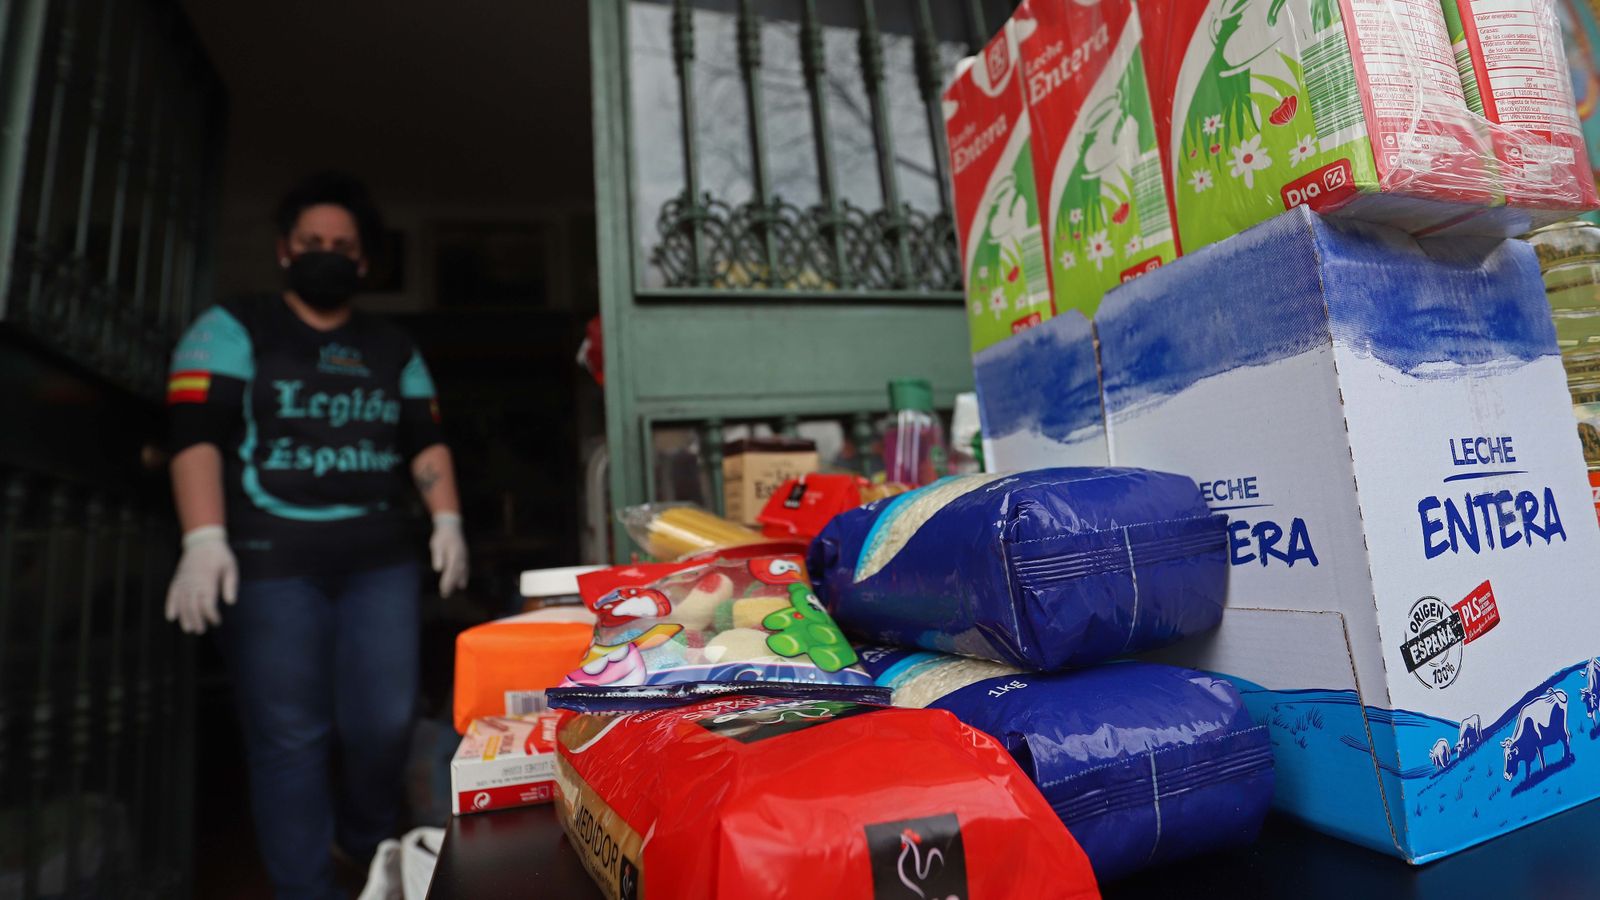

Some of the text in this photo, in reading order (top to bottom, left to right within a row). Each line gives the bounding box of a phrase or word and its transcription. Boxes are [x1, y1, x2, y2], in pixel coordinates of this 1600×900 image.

[1025, 40, 1063, 77] Leche
[1030, 22, 1109, 106] Entera
[953, 112, 1008, 175] Entera
[272, 379, 401, 428] Legión
[1449, 436, 1517, 466] LECHE
[1199, 476, 1260, 502] ECHE
[1226, 517, 1320, 568] ERA
[1418, 486, 1567, 560] ENTERA
[1410, 602, 1444, 634] ORIGEN
[1461, 596, 1482, 627] PLS
[1409, 623, 1458, 665] ESPAÑA
[988, 680, 1028, 698] 1kg
[1432, 661, 1456, 684] 100%
[574, 805, 619, 879] MEDIDOR
